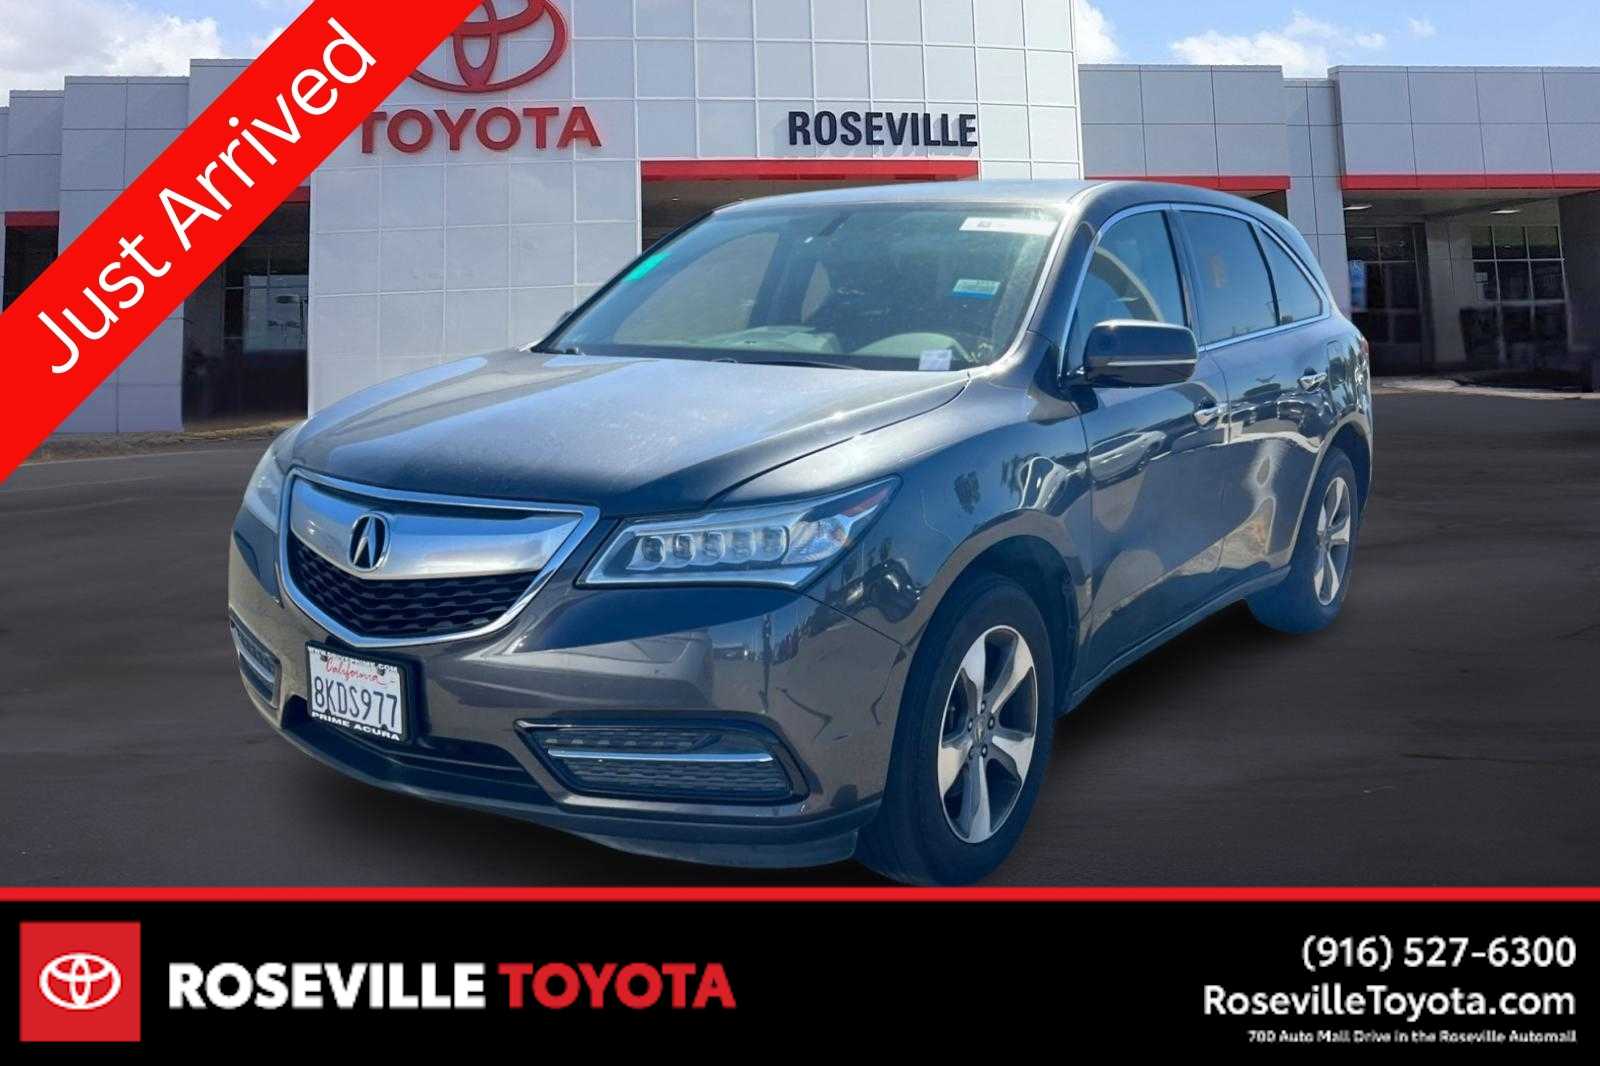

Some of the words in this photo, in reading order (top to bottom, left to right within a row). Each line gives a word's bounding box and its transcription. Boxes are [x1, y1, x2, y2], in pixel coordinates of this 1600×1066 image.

[359, 106, 602, 155] TOYOTA
[788, 110, 978, 147] ROSEVILLE
[314, 676, 398, 728] 8KDS977
[311, 711, 351, 728] PRIME
[353, 722, 400, 741] ACURA
